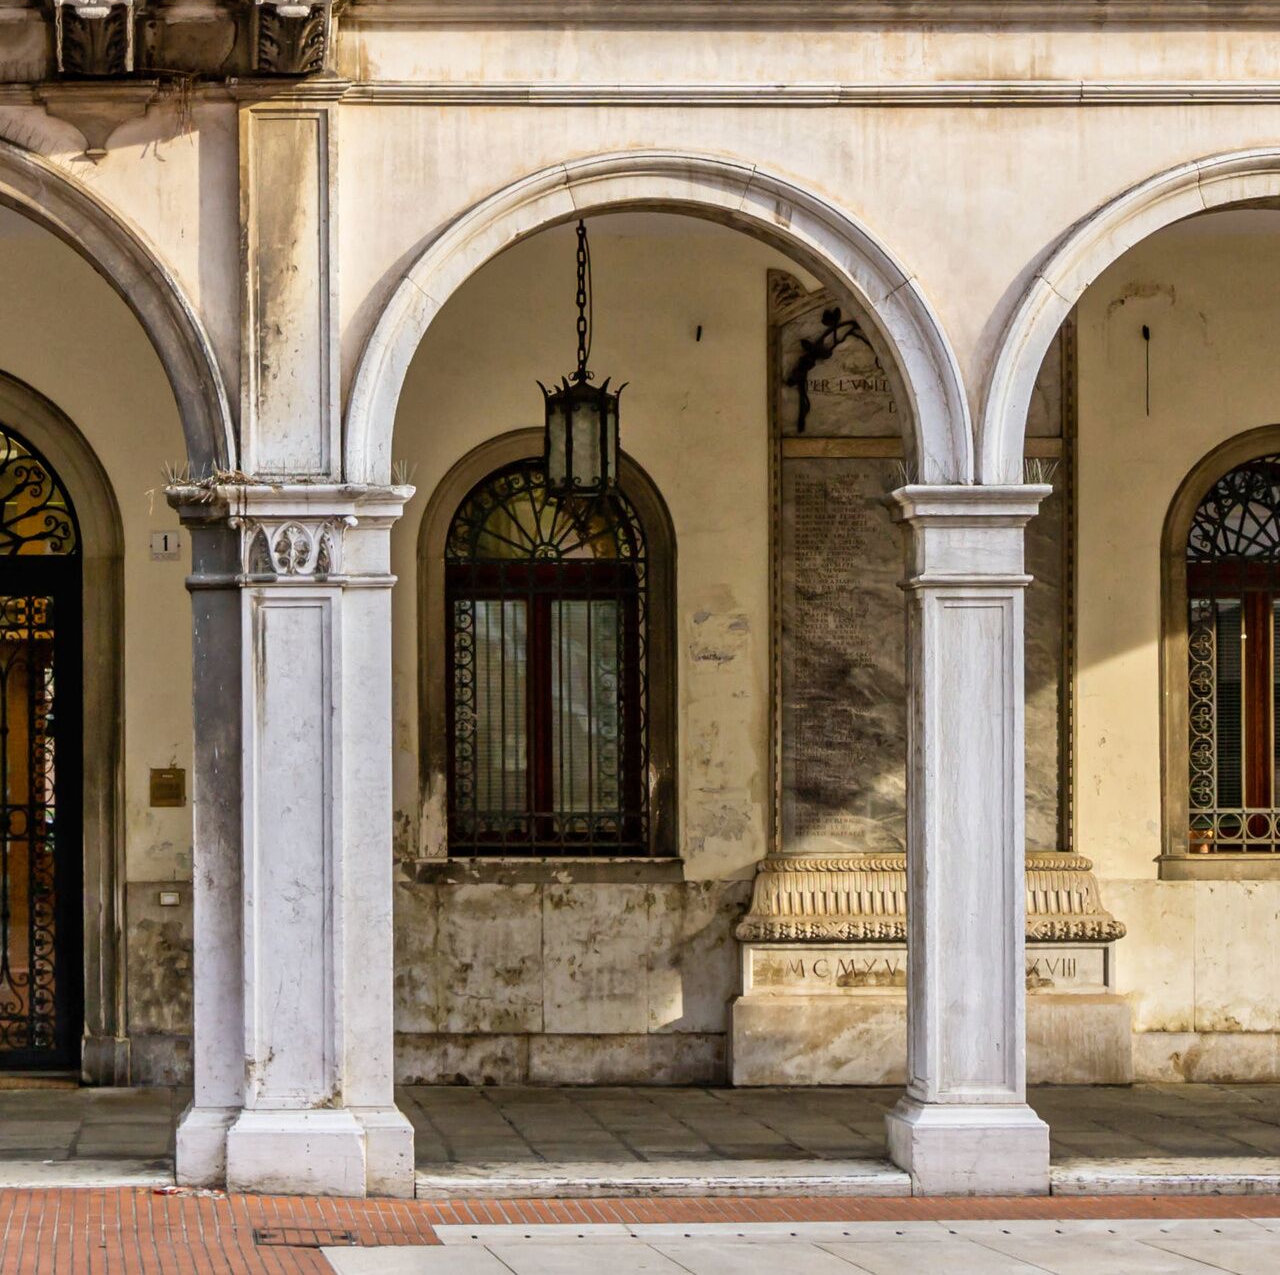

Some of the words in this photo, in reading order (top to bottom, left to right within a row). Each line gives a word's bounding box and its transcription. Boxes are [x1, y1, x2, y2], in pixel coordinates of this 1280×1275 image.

[839, 379, 893, 392] L'VNIT
[162, 535, 168, 552] 1
[1026, 956, 1077, 978] XVIII
